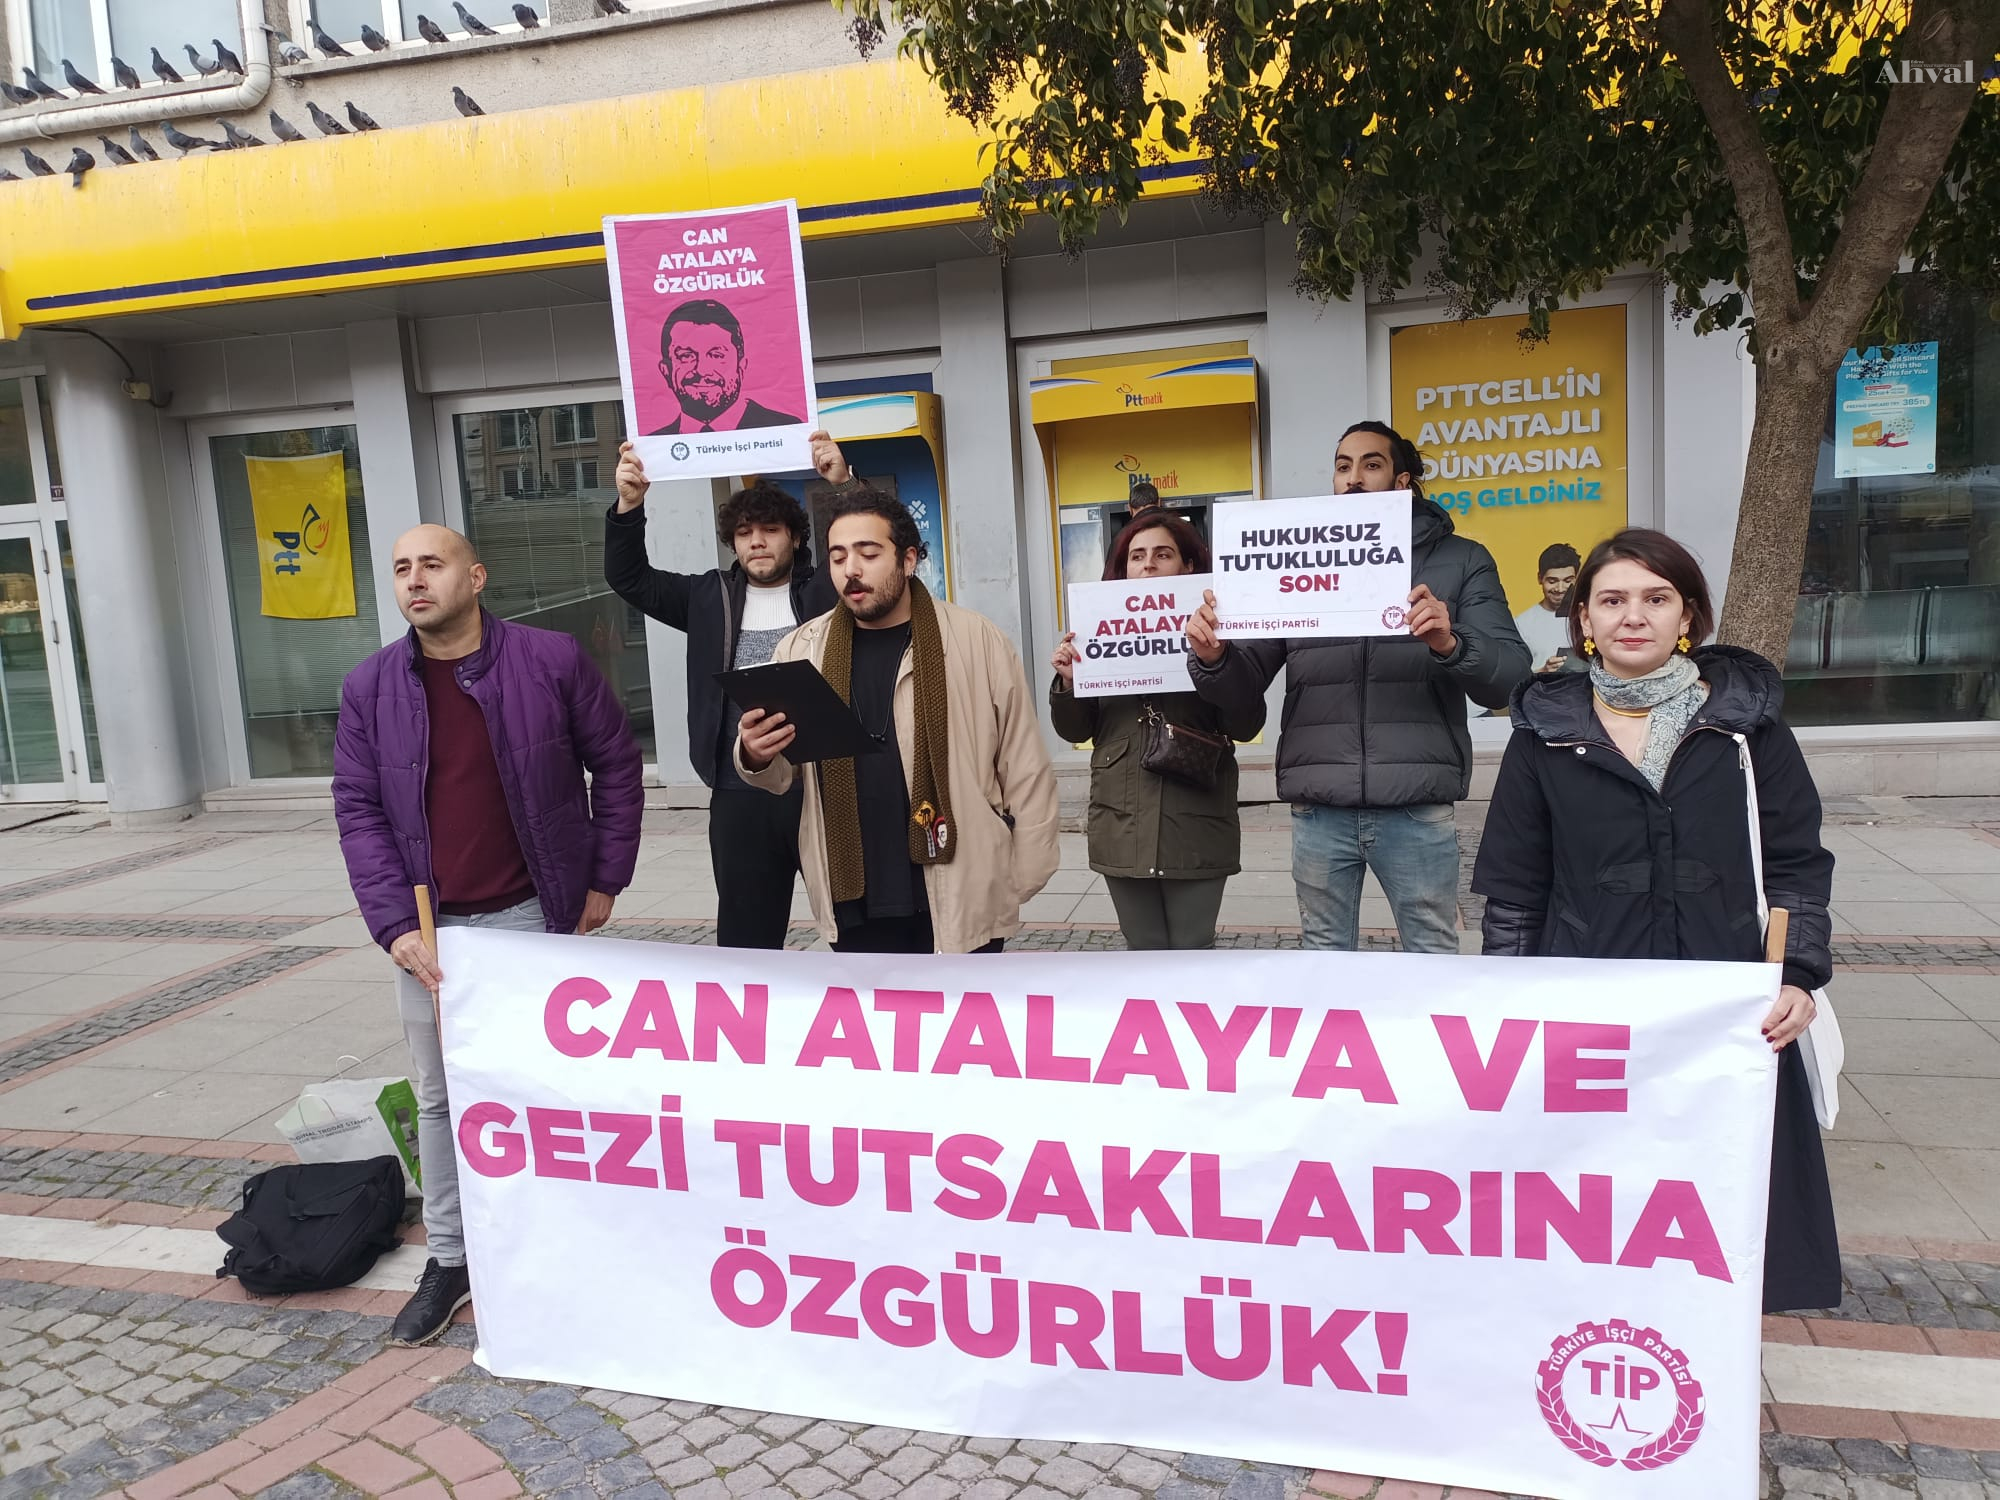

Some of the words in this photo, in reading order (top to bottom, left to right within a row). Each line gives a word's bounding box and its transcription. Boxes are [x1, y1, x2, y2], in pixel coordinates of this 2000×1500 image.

[682, 228, 727, 247] CAN
[653, 269, 765, 294] ÖZGÜRLÜK
[1125, 391, 1163, 407] Pttmatik
[1417, 408, 1600, 446] AVANTAJLI
[696, 444, 732, 454] Türkiye
[735, 441, 751, 452] İşçi
[753, 438, 783, 450] Partisi
[1422, 446, 1601, 481] DÜNYASINA
[1430, 491, 1472, 515] OŞ
[1477, 477, 1601, 508] GELDİNİZ
[1241, 523, 1381, 548] HUKUKSUZ
[273, 531, 302, 576] Ptt
[1219, 542, 1404, 572] TUTUKLULUĞA
[1279, 573, 1340, 593] SON!
[1125, 593, 1175, 612] CAN
[1219, 620, 1260, 630] TÜRKİYE
[1262, 619, 1280, 631] İŞÇİ
[1282, 617, 1319, 628] PARTİSİ
[1085, 632, 1191, 659] ÖZGÜRLÜ
[1079, 680, 1113, 690] TÜRKİYE
[1115, 679, 1130, 689] İŞÇİ
[1132, 676, 1163, 687] PARTİSİ
[544, 976, 768, 1064] CAN
[795, 986, 1398, 1105] ATALAY'A
[1429, 1014, 1630, 1113] VE
[458, 1094, 689, 1191] GEZİ
[714, 1119, 1734, 1284] TUTSAKLARINA
[710, 1226, 1408, 1396] ÖZGÜRLÜK!
[1549, 1330, 1596, 1373] TÜRKİYE
[1604, 1325, 1636, 1342] İŞÇİ
[1643, 1336, 1693, 1387] PARTİSİ
[1582, 1355, 1661, 1401] TİP
